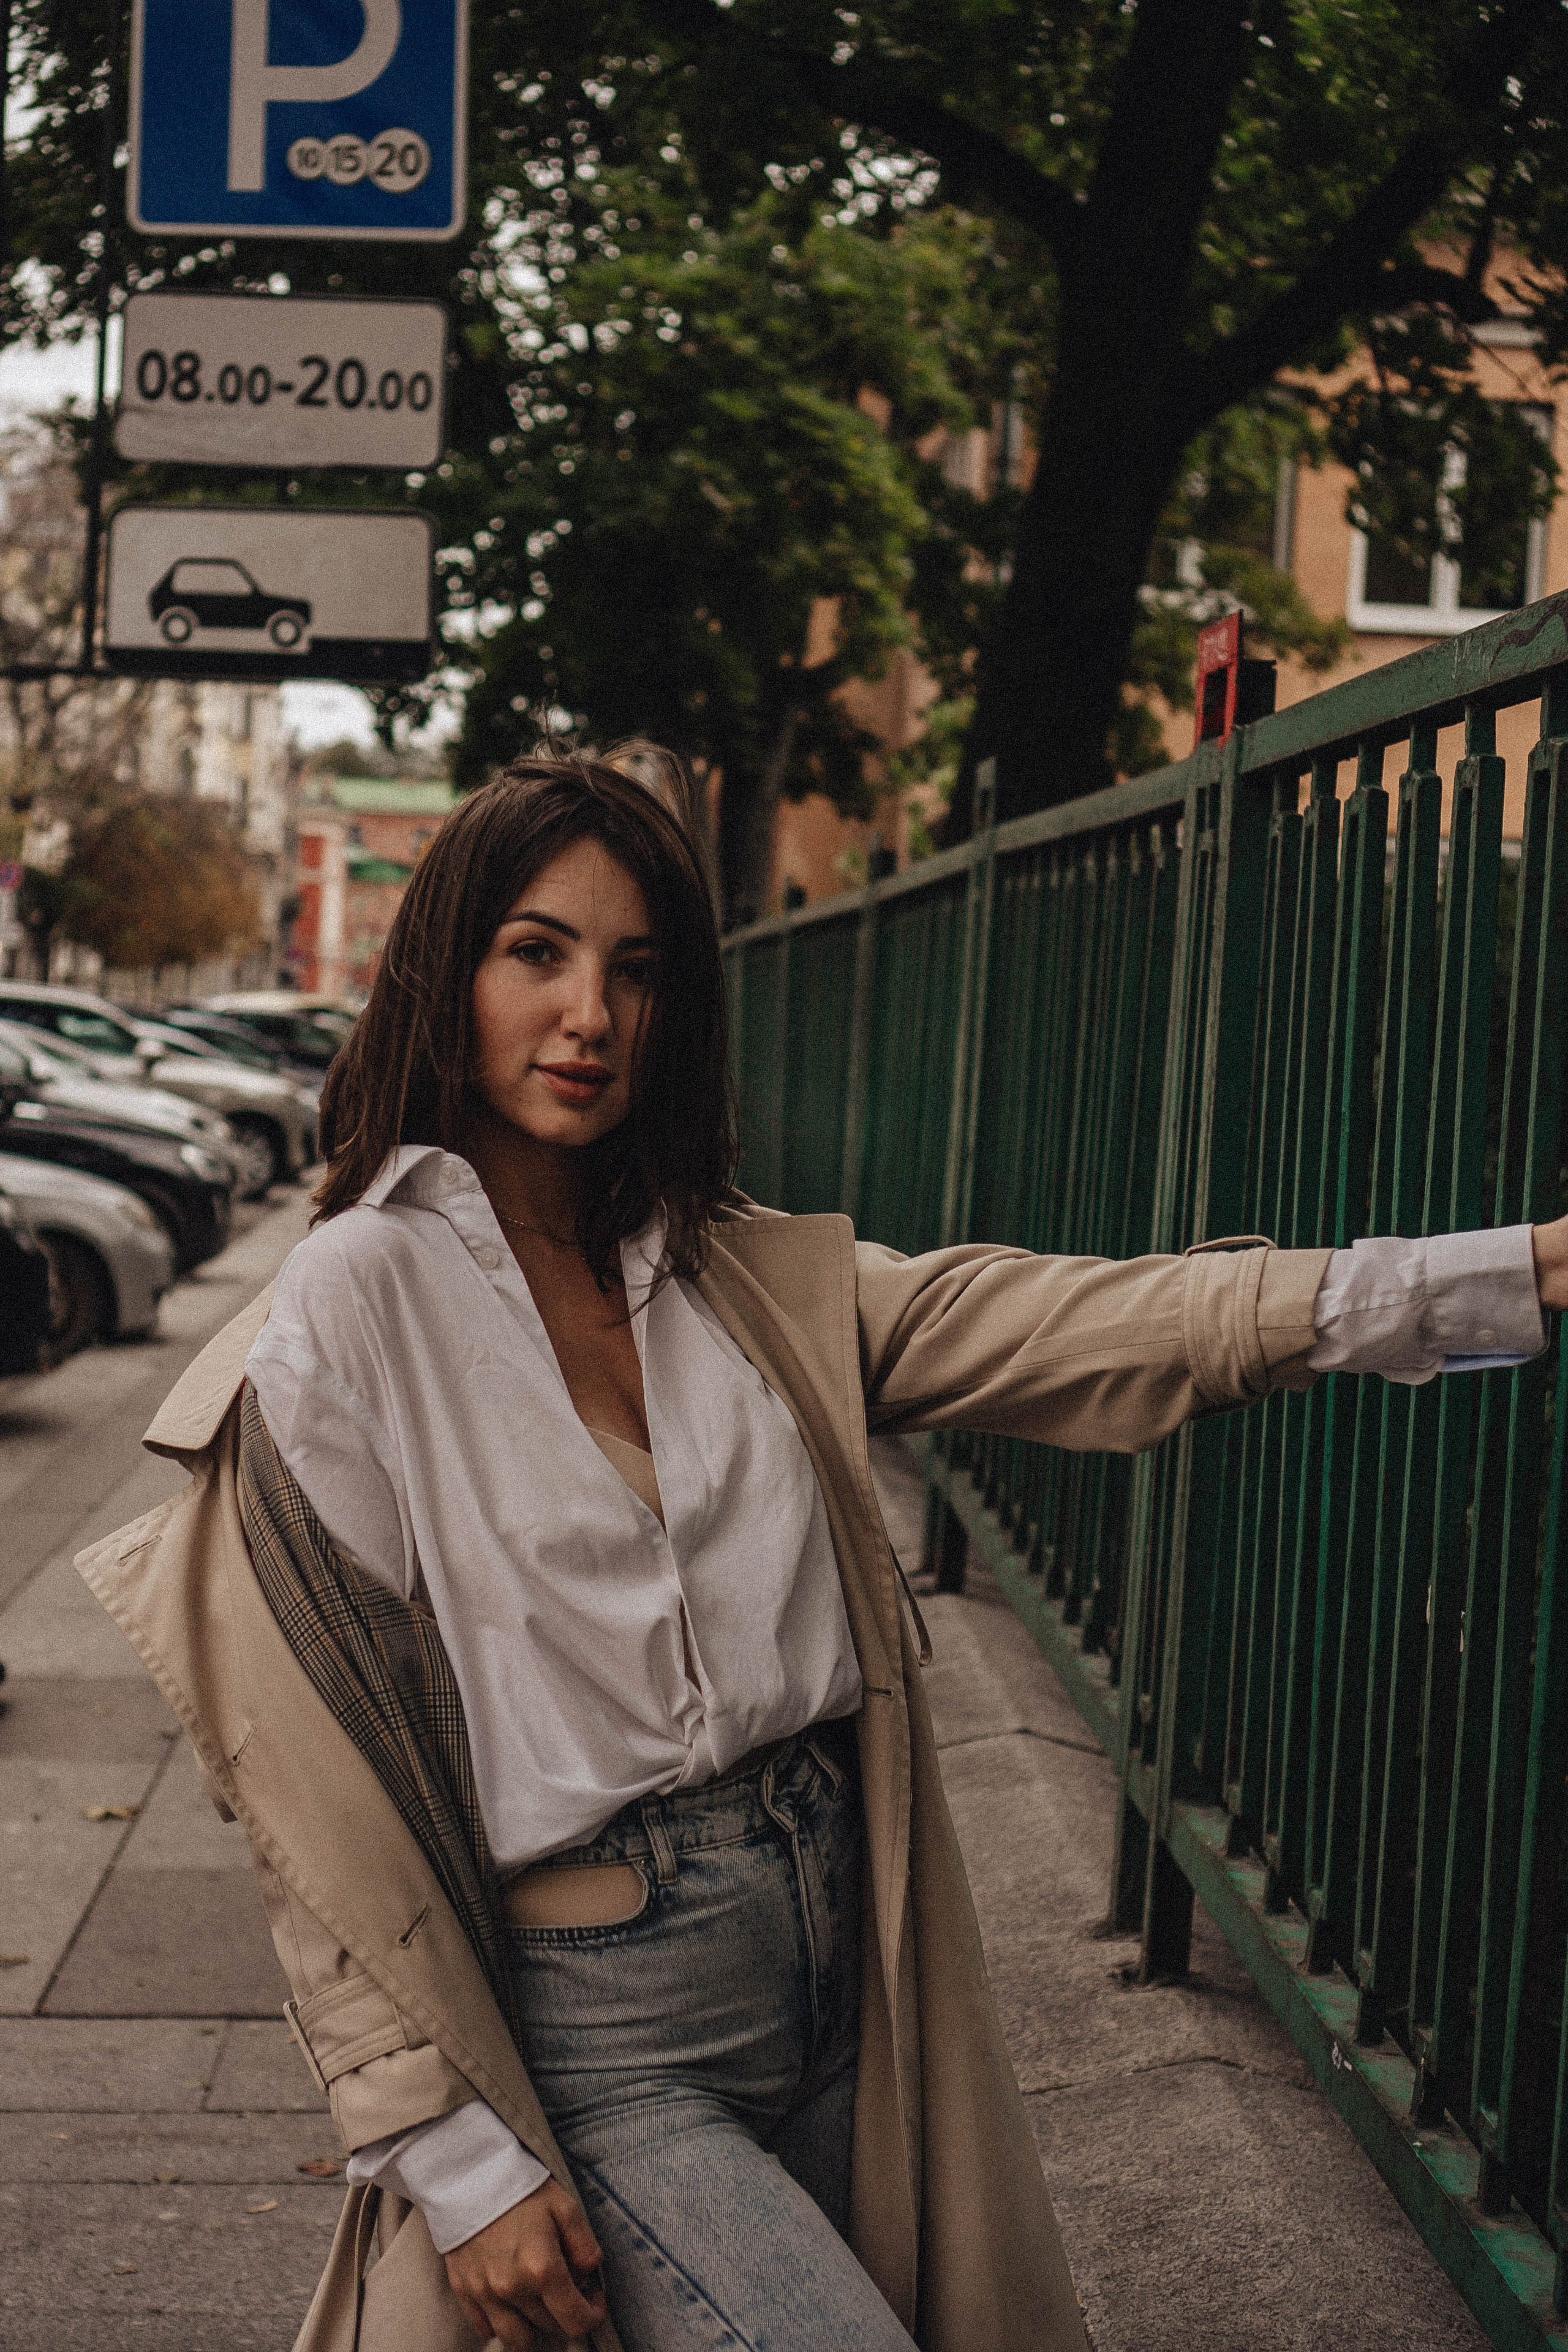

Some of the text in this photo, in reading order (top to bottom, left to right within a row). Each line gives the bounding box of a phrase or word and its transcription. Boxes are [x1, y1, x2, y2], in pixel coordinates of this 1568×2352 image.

[227, 0, 402, 192] P
[333, 145, 360, 172] 15
[375, 142, 422, 176] 20
[137, 350, 432, 412] 08.00-20.00
